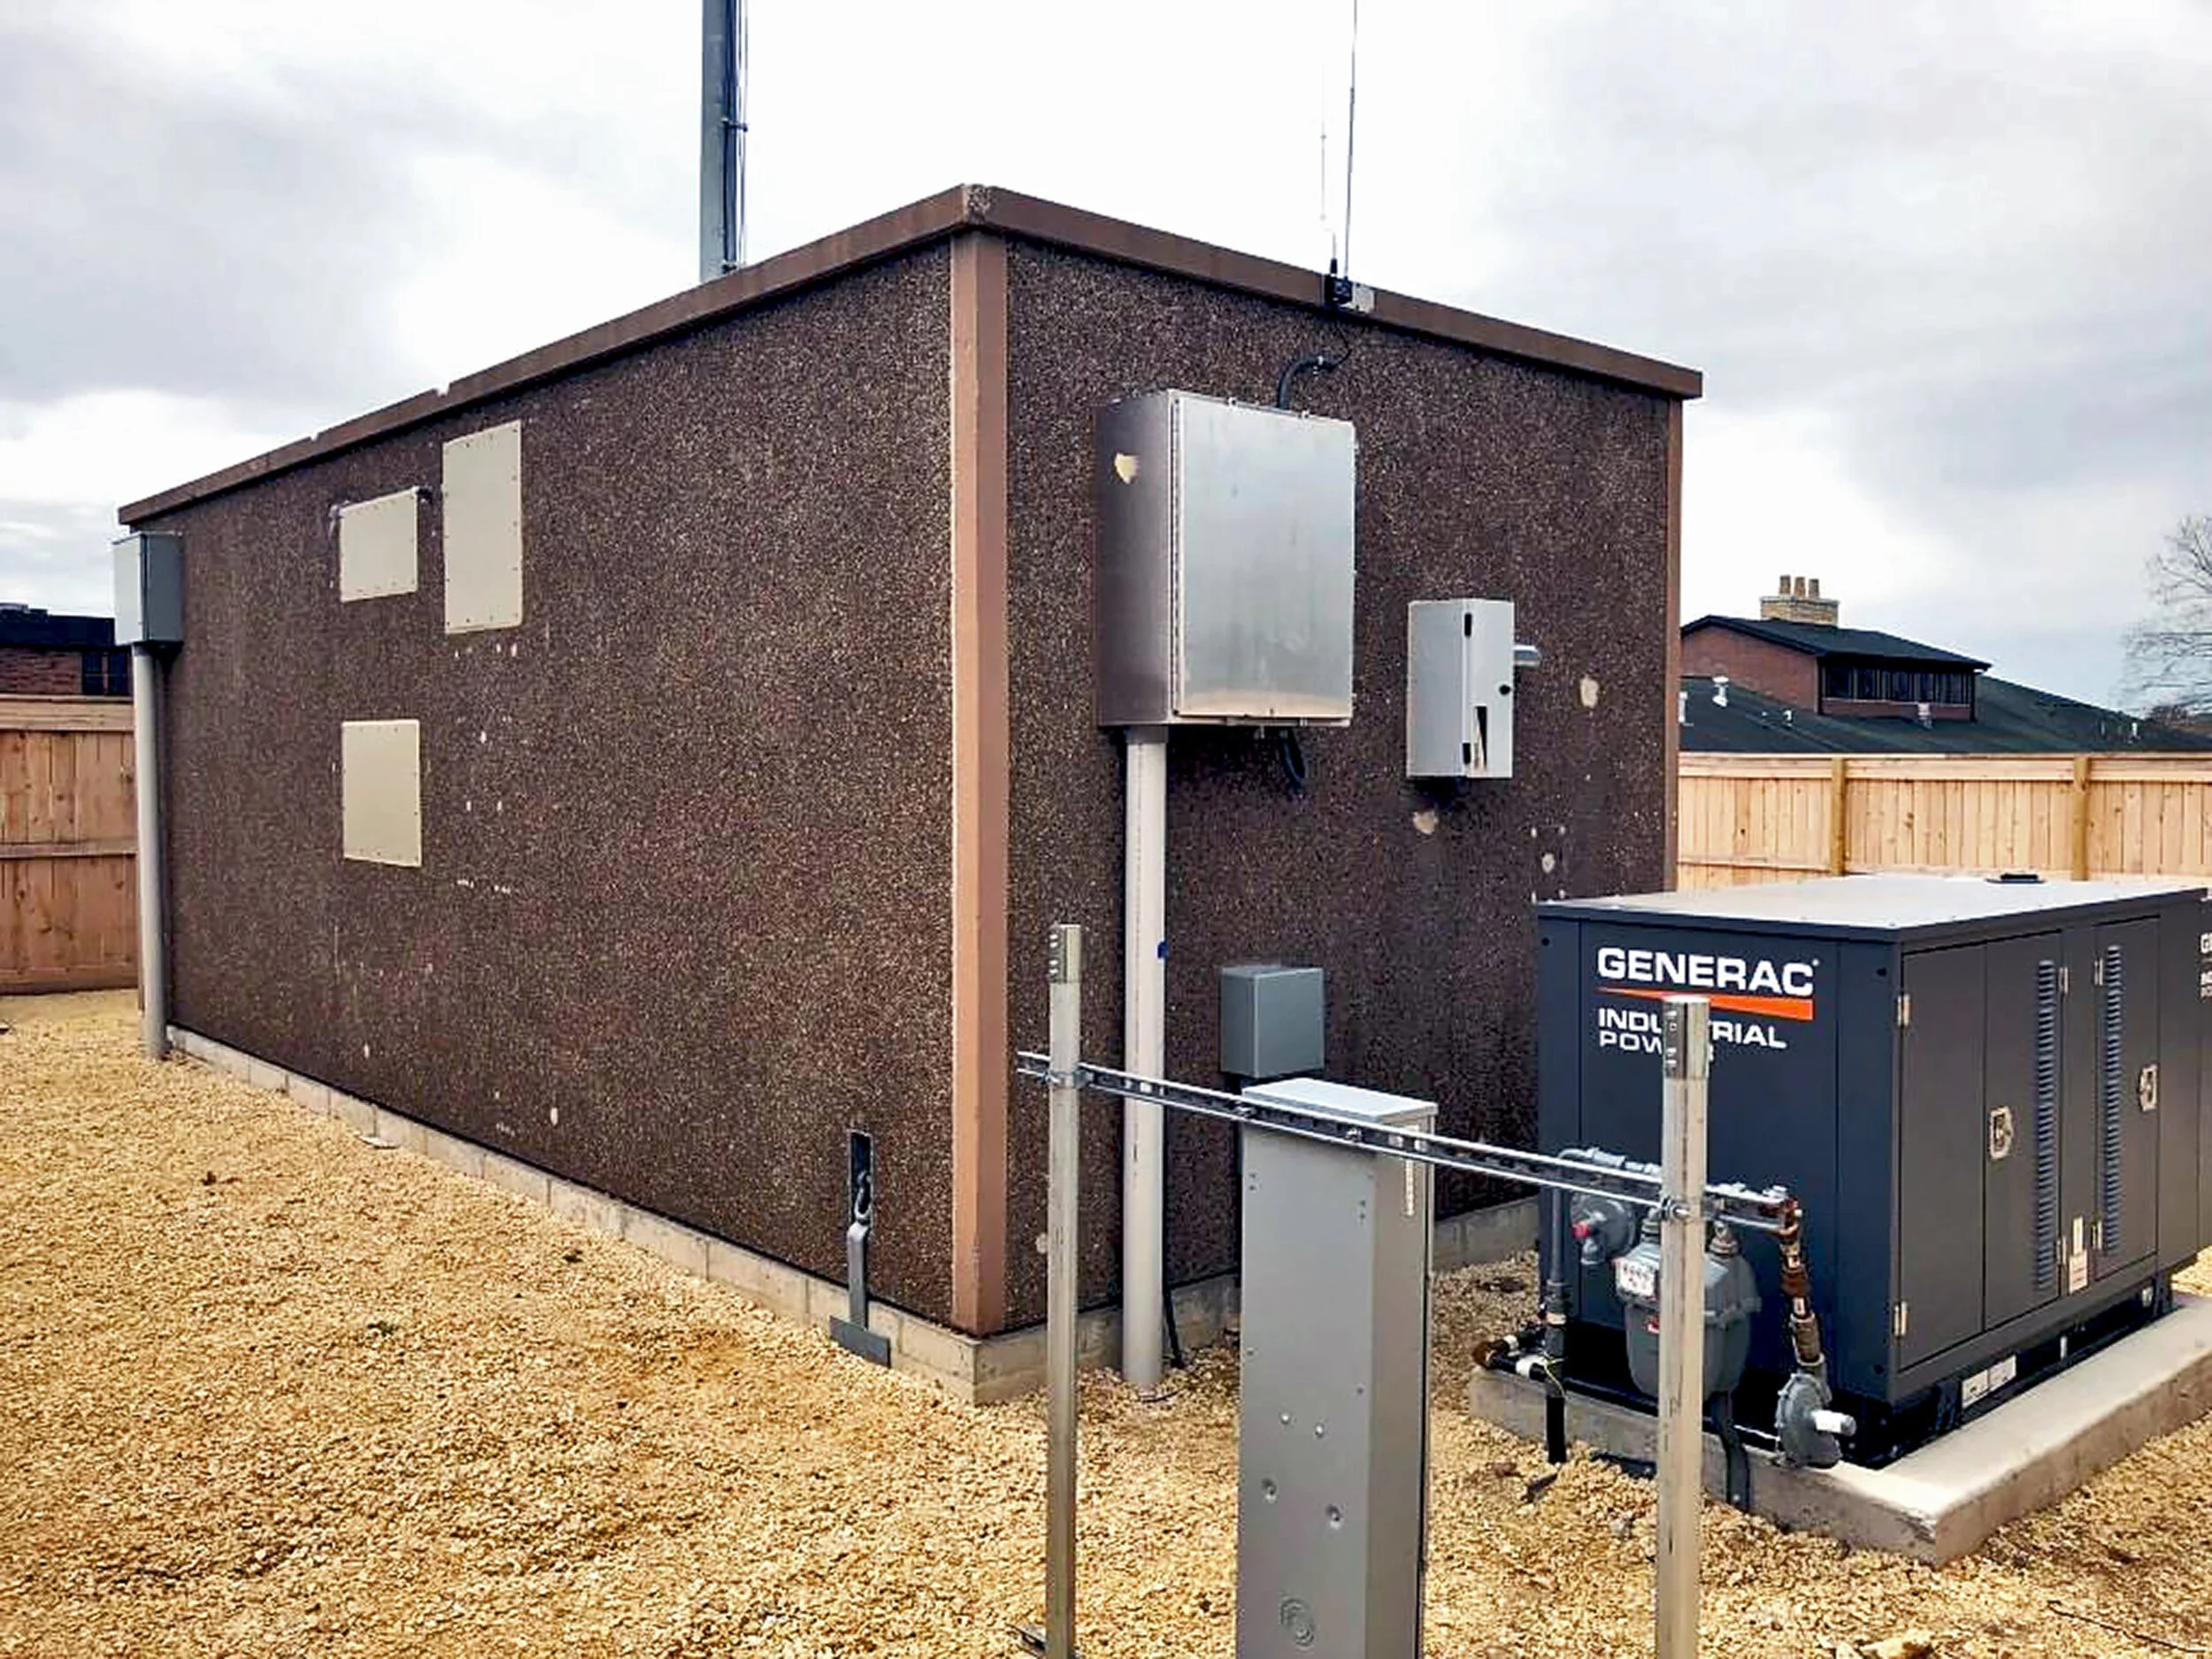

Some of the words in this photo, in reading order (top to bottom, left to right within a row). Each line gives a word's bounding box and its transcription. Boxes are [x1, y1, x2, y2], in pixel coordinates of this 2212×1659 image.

[1597, 947, 1814, 996] GENERAC
[1598, 1008, 1787, 1049] INDURIAL
[1599, 1030, 1715, 1061] POW
